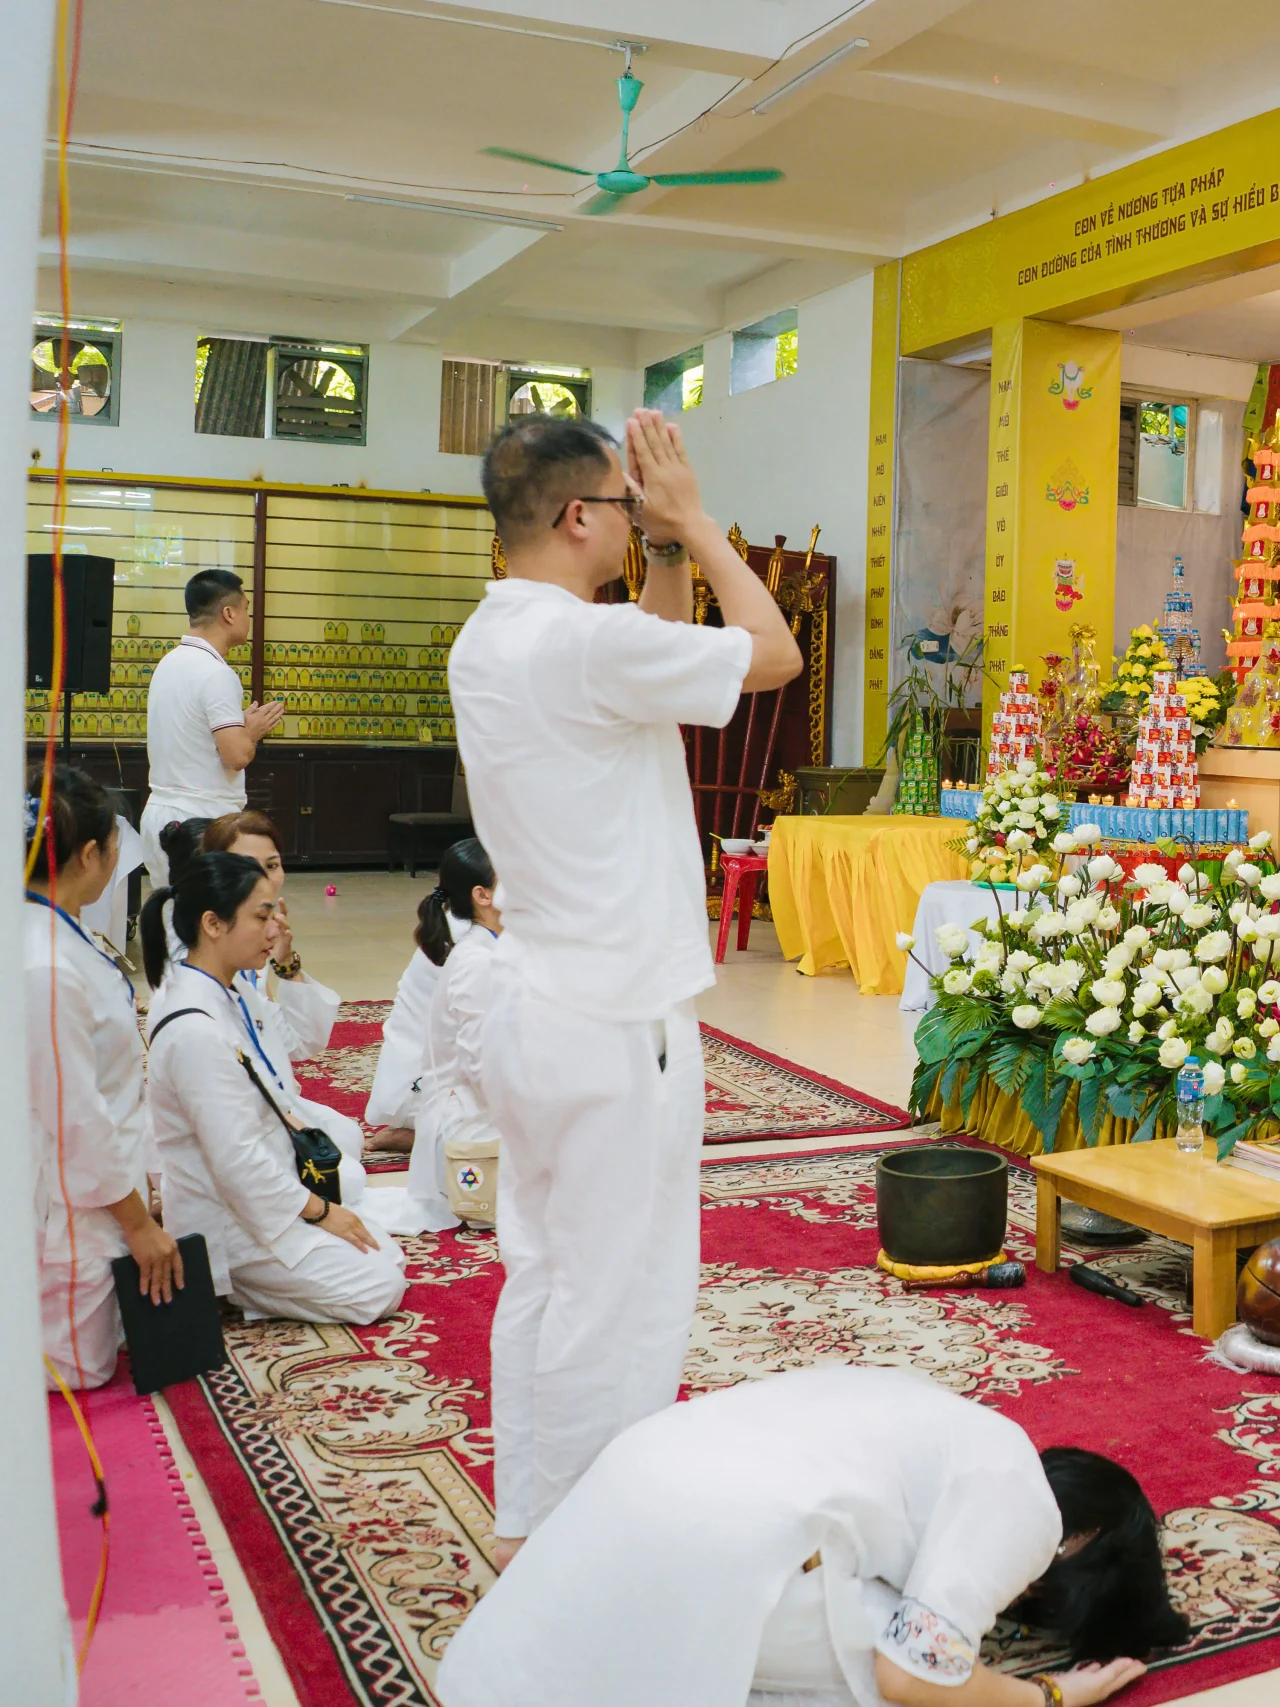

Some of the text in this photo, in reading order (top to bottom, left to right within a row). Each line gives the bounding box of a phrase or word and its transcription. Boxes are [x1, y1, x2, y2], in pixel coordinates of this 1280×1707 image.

[1018, 264, 1039, 286] CON
[1041, 250, 1077, 278] ĐƯỜNG
[1080, 240, 1102, 265] CỦA
[1105, 231, 1132, 255] TÌNH
[1136, 214, 1186, 246] THƯƠNG
[1190, 204, 1208, 228] VÀ
[1211, 198, 1229, 222] SỰ
[1232, 182, 1265, 215] HIỂU
[1074, 167, 1225, 238] CON VỀ NƯƠNG TỰA PHÁP
